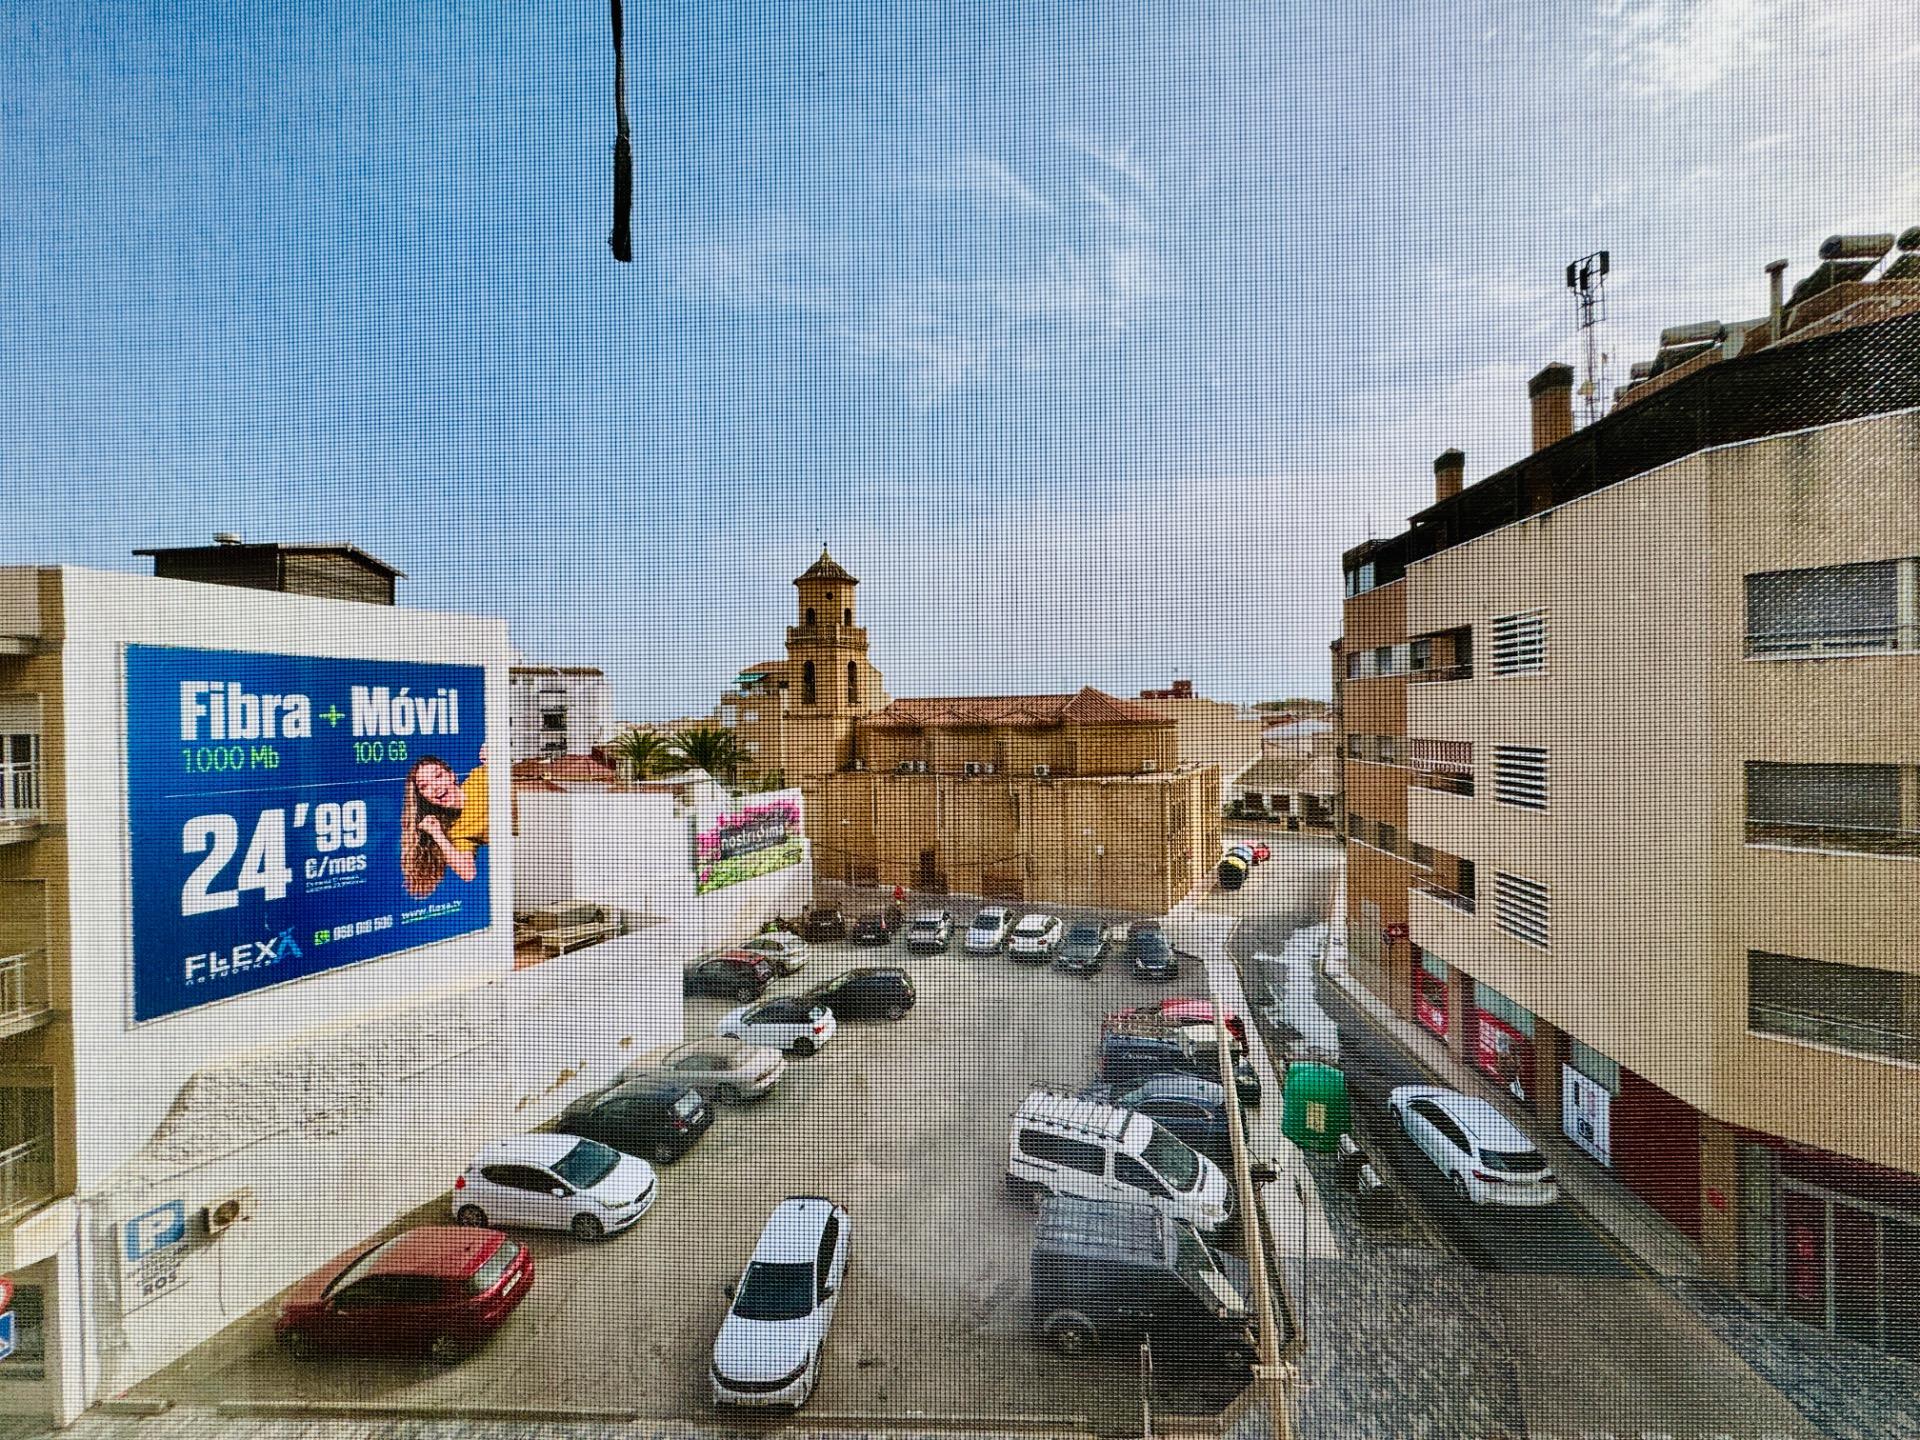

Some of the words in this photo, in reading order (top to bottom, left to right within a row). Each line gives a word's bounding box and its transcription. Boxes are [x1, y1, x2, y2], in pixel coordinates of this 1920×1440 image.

[180, 681, 312, 740] Fibra
[318, 705, 346, 728] +
[351, 685, 460, 737] Móvil
[250, 745, 280, 769] Mb
[353, 741, 384, 764] 100
[388, 741, 408, 761] GB
[305, 854, 367, 879] €/mes
[138, 1208, 175, 1254] P
